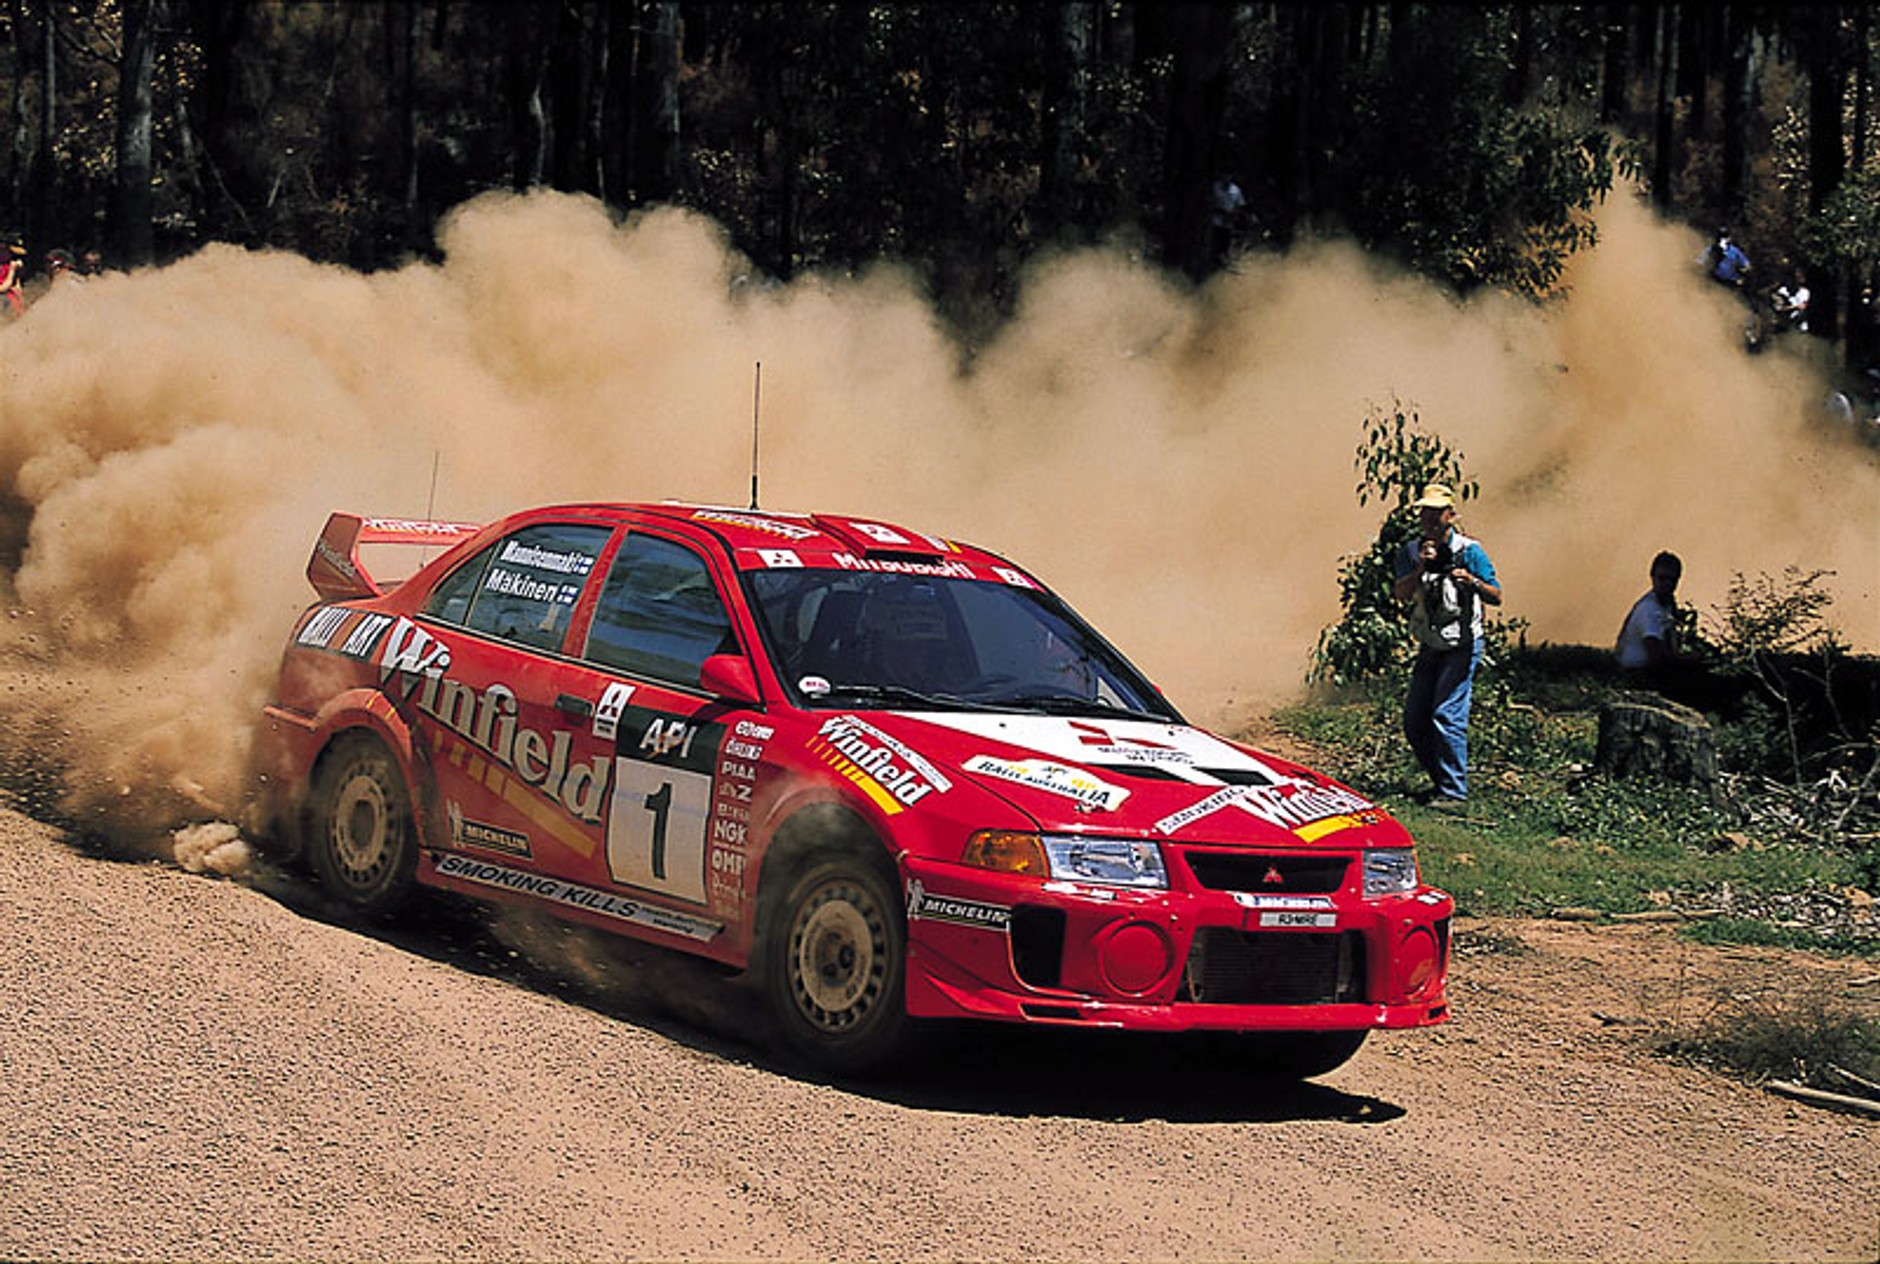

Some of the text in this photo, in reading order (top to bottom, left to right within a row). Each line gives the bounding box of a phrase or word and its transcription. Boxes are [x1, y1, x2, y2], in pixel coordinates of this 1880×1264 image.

[485, 568, 558, 602] Mäkinen
[380, 615, 611, 827] Winfield
[640, 718, 697, 758] API
[818, 716, 933, 807] Winfield
[644, 782, 673, 880] 1
[714, 820, 748, 844] NGK
[442, 857, 560, 897] SMOKING
[562, 885, 640, 918] KILLS
[924, 900, 1011, 922] MICHELIN
